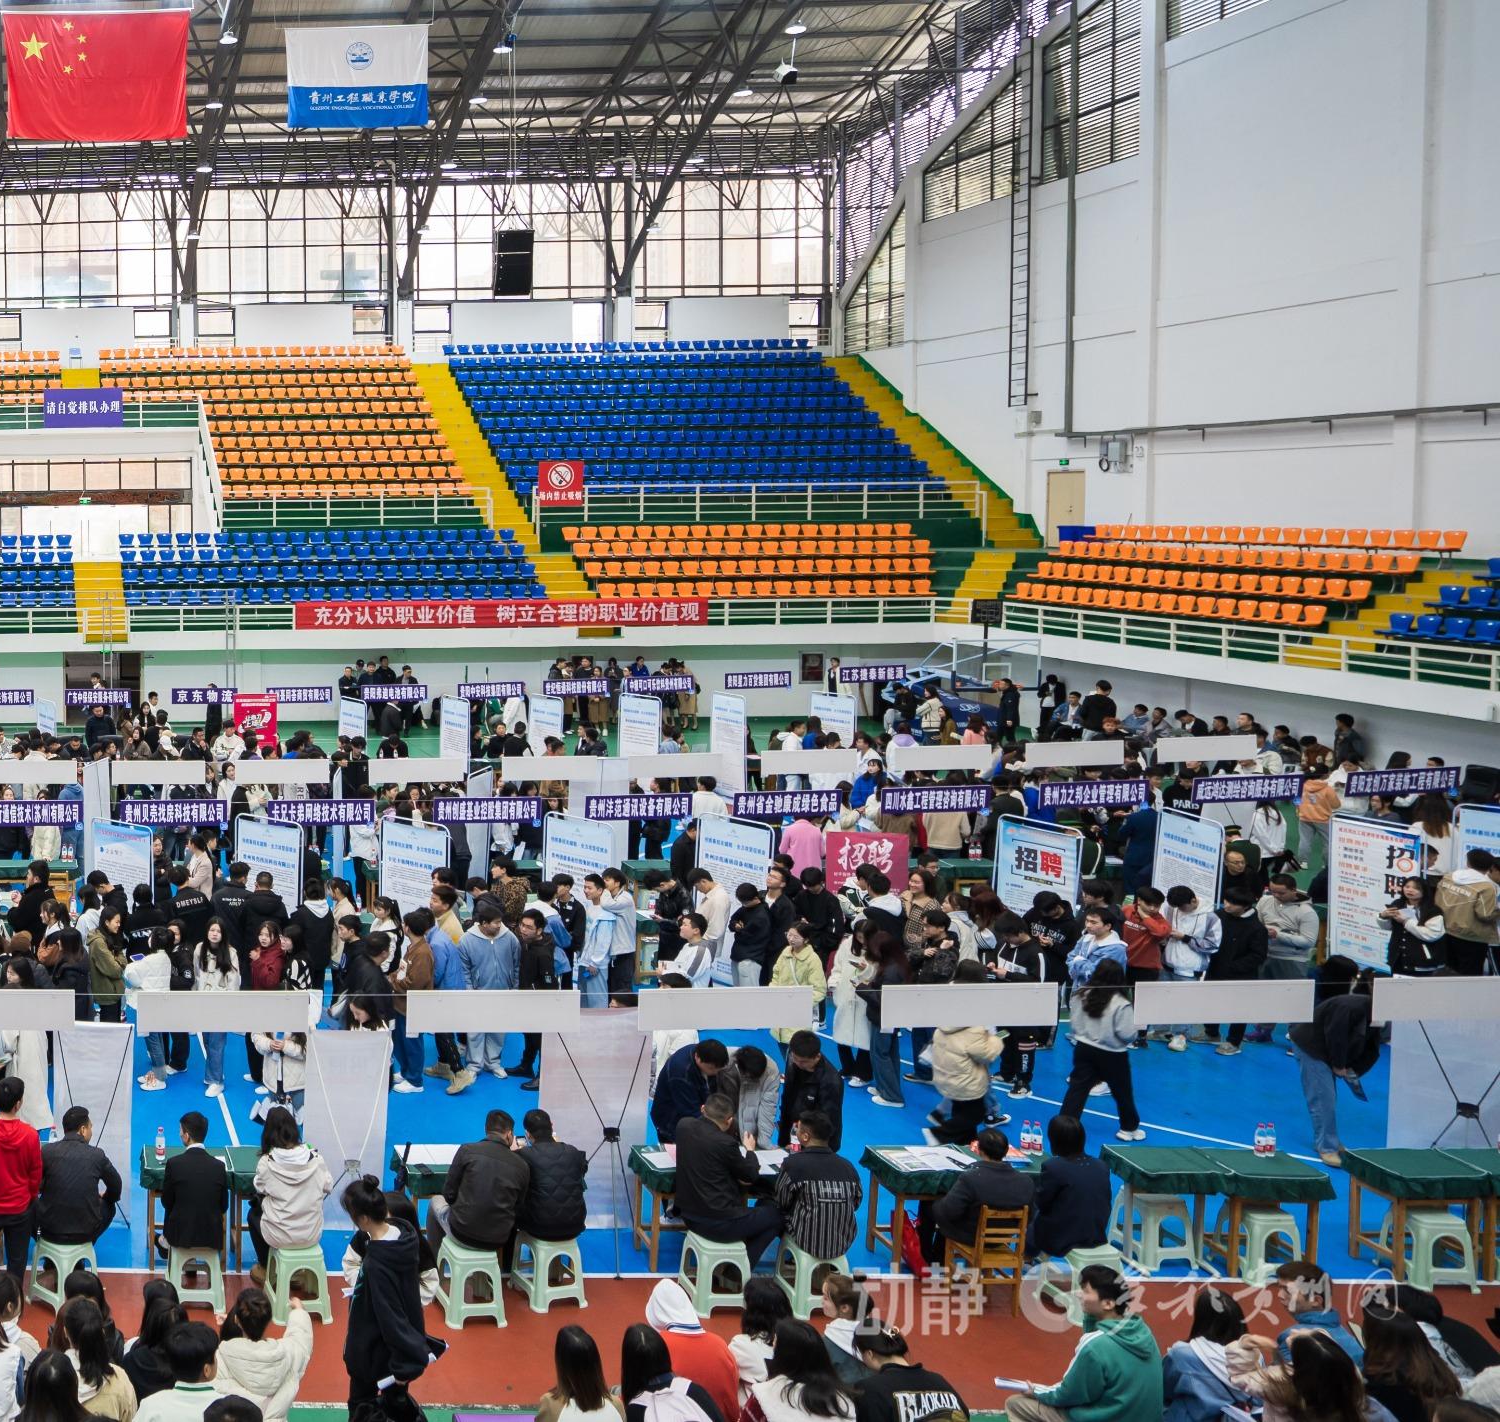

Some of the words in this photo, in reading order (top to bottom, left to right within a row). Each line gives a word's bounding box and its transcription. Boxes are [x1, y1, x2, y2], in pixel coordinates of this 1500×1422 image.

[46, 400, 120, 415] 请自觉排队办理
[314, 604, 476, 626] 充分认识职业价值
[497, 602, 700, 623] 树立合理的职业价值观
[176, 690, 233, 703] 京东物流
[1043, 783, 1146, 806] 贵州力之邦企业管理有限公司
[125, 802, 224, 823] 贵州贝壳找房科技有限公司
[272, 802, 371, 823] 卡兄卡弟网络技术有限公司
[438, 800, 537, 821] 贵州创盛基业控股集团有限公司
[838, 836, 894, 874] 招聘
[1015, 846, 1062, 878] 招聘
